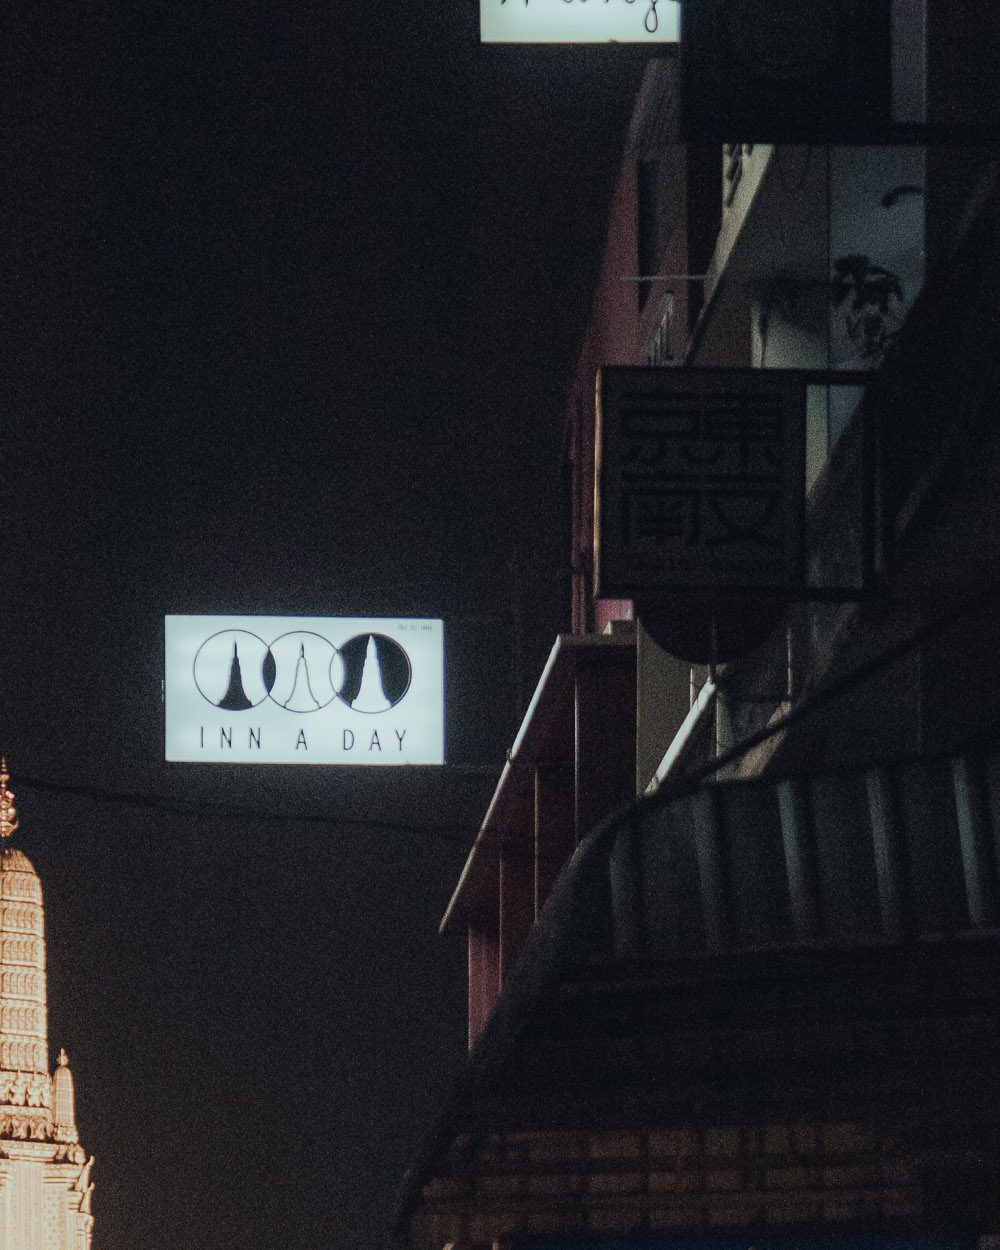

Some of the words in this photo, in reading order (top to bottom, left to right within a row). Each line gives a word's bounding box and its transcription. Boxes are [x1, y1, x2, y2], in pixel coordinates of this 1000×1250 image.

[199, 726, 262, 749] INN
[295, 728, 308, 751] A
[342, 729, 407, 752] DAY
